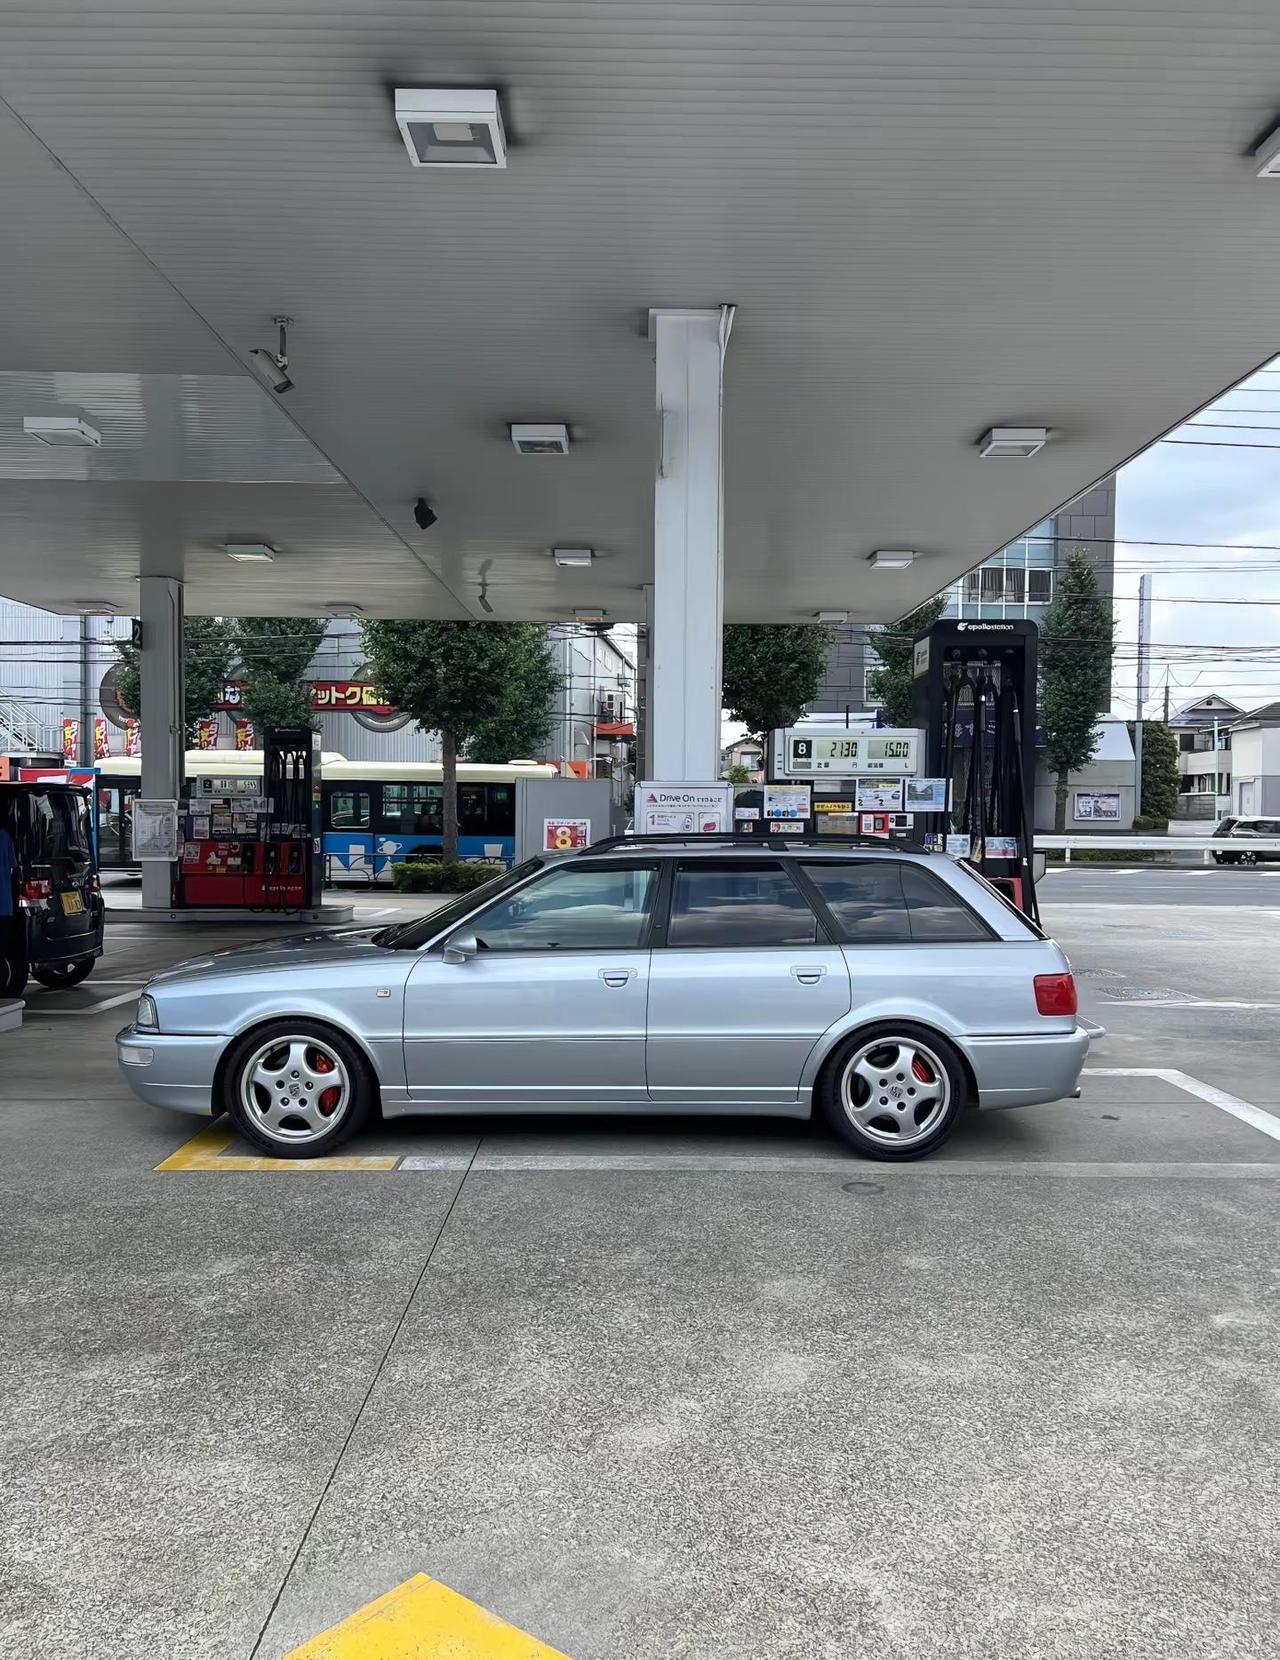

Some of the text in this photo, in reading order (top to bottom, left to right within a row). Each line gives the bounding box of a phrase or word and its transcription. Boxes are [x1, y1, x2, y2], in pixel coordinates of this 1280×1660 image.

[967, 622, 1014, 632] apollostation
[134, 624, 141, 644] 2
[798, 743, 806, 754] 8
[830, 742, 858, 757] 2130
[884, 742, 909, 757] 15.00
[659, 794, 681, 803] Drive
[682, 794, 695, 802] On
[649, 815, 655, 825] 1
